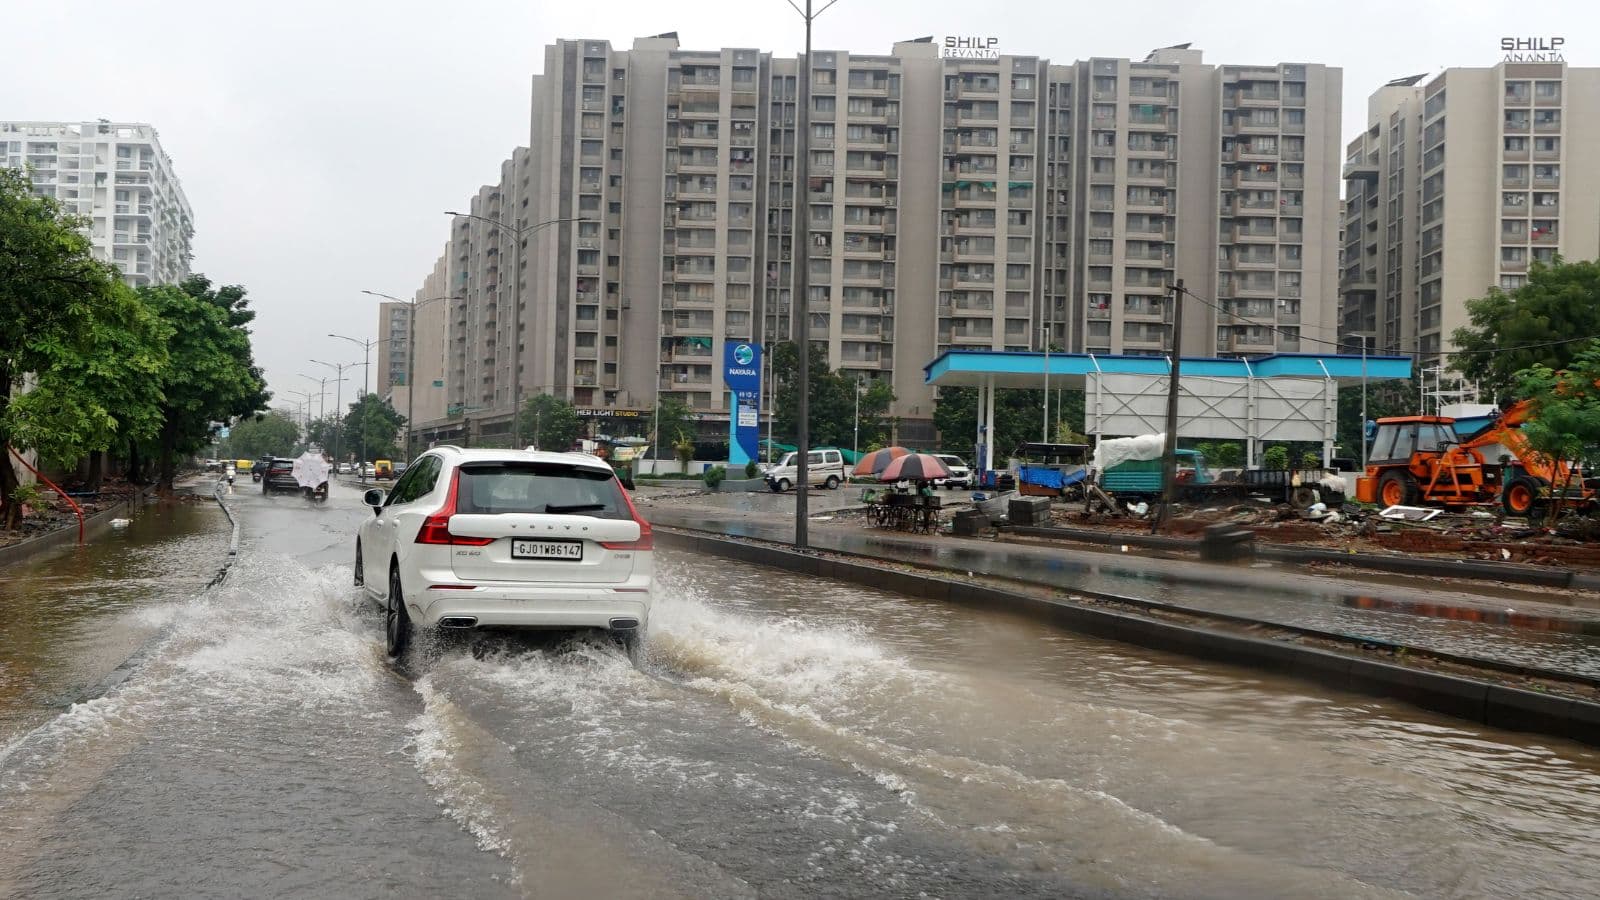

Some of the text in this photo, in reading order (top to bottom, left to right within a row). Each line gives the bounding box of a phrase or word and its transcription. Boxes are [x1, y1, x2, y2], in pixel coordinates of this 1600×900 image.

[945, 36, 998, 48] SHILP
[1501, 37, 1564, 50] SHILP
[944, 48, 998, 57] REVANTA
[1504, 53, 1564, 62] ANANTA
[729, 368, 756, 376] NAYARA
[519, 543, 580, 556] GJ01WB6147
